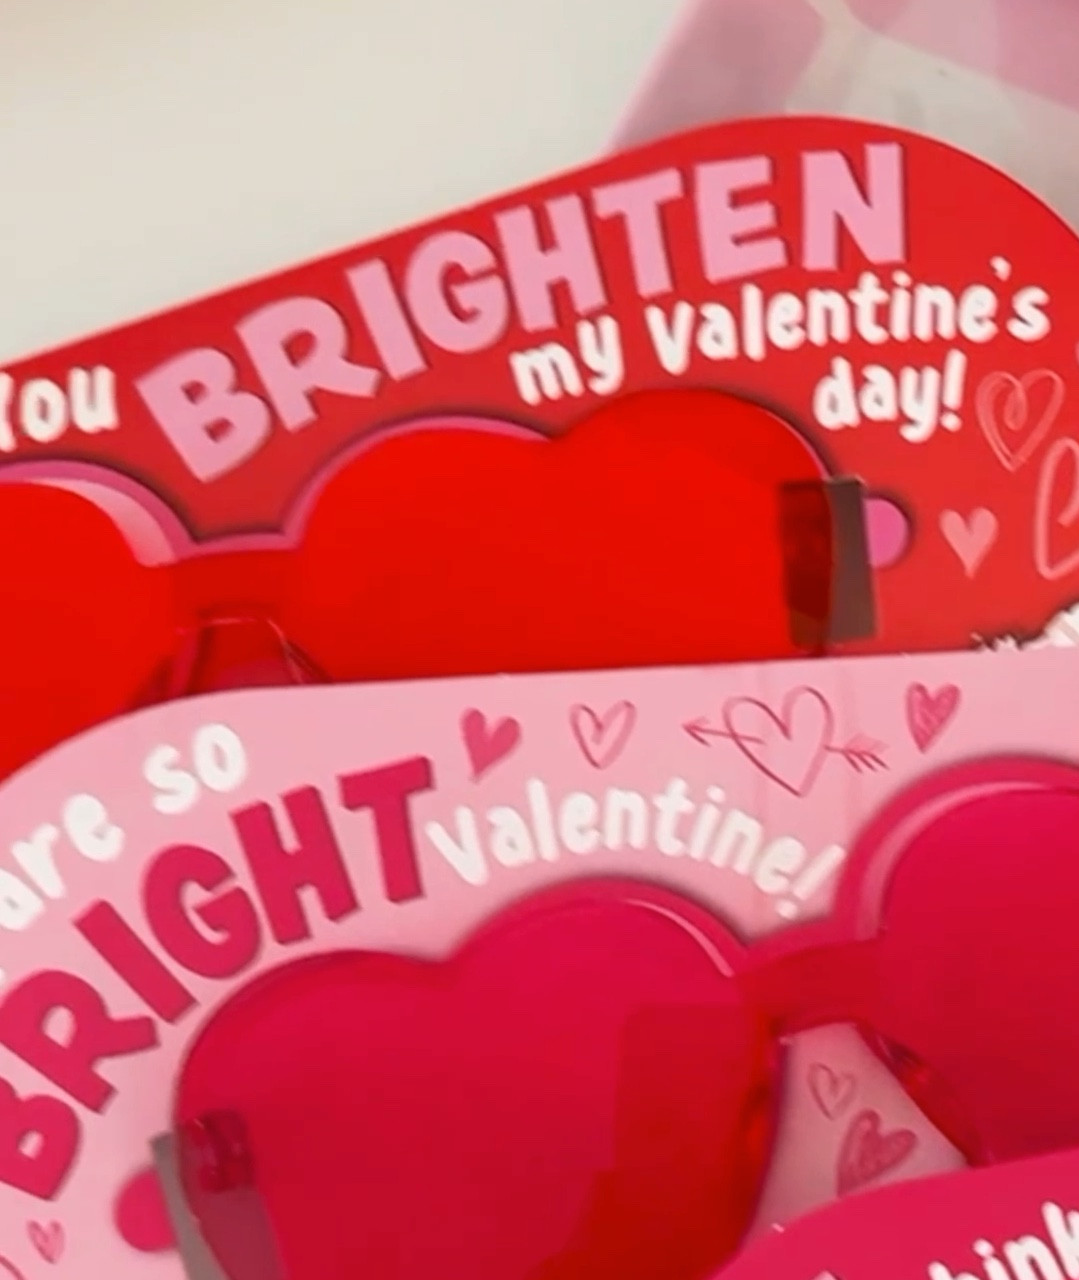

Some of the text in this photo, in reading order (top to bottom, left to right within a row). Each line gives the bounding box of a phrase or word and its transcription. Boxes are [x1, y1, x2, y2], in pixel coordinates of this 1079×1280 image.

[138, 145, 902, 482] BRIGHTEN
[512, 314, 622, 403] my
[815, 351, 964, 441] day!
[145, 725, 246, 813] so
